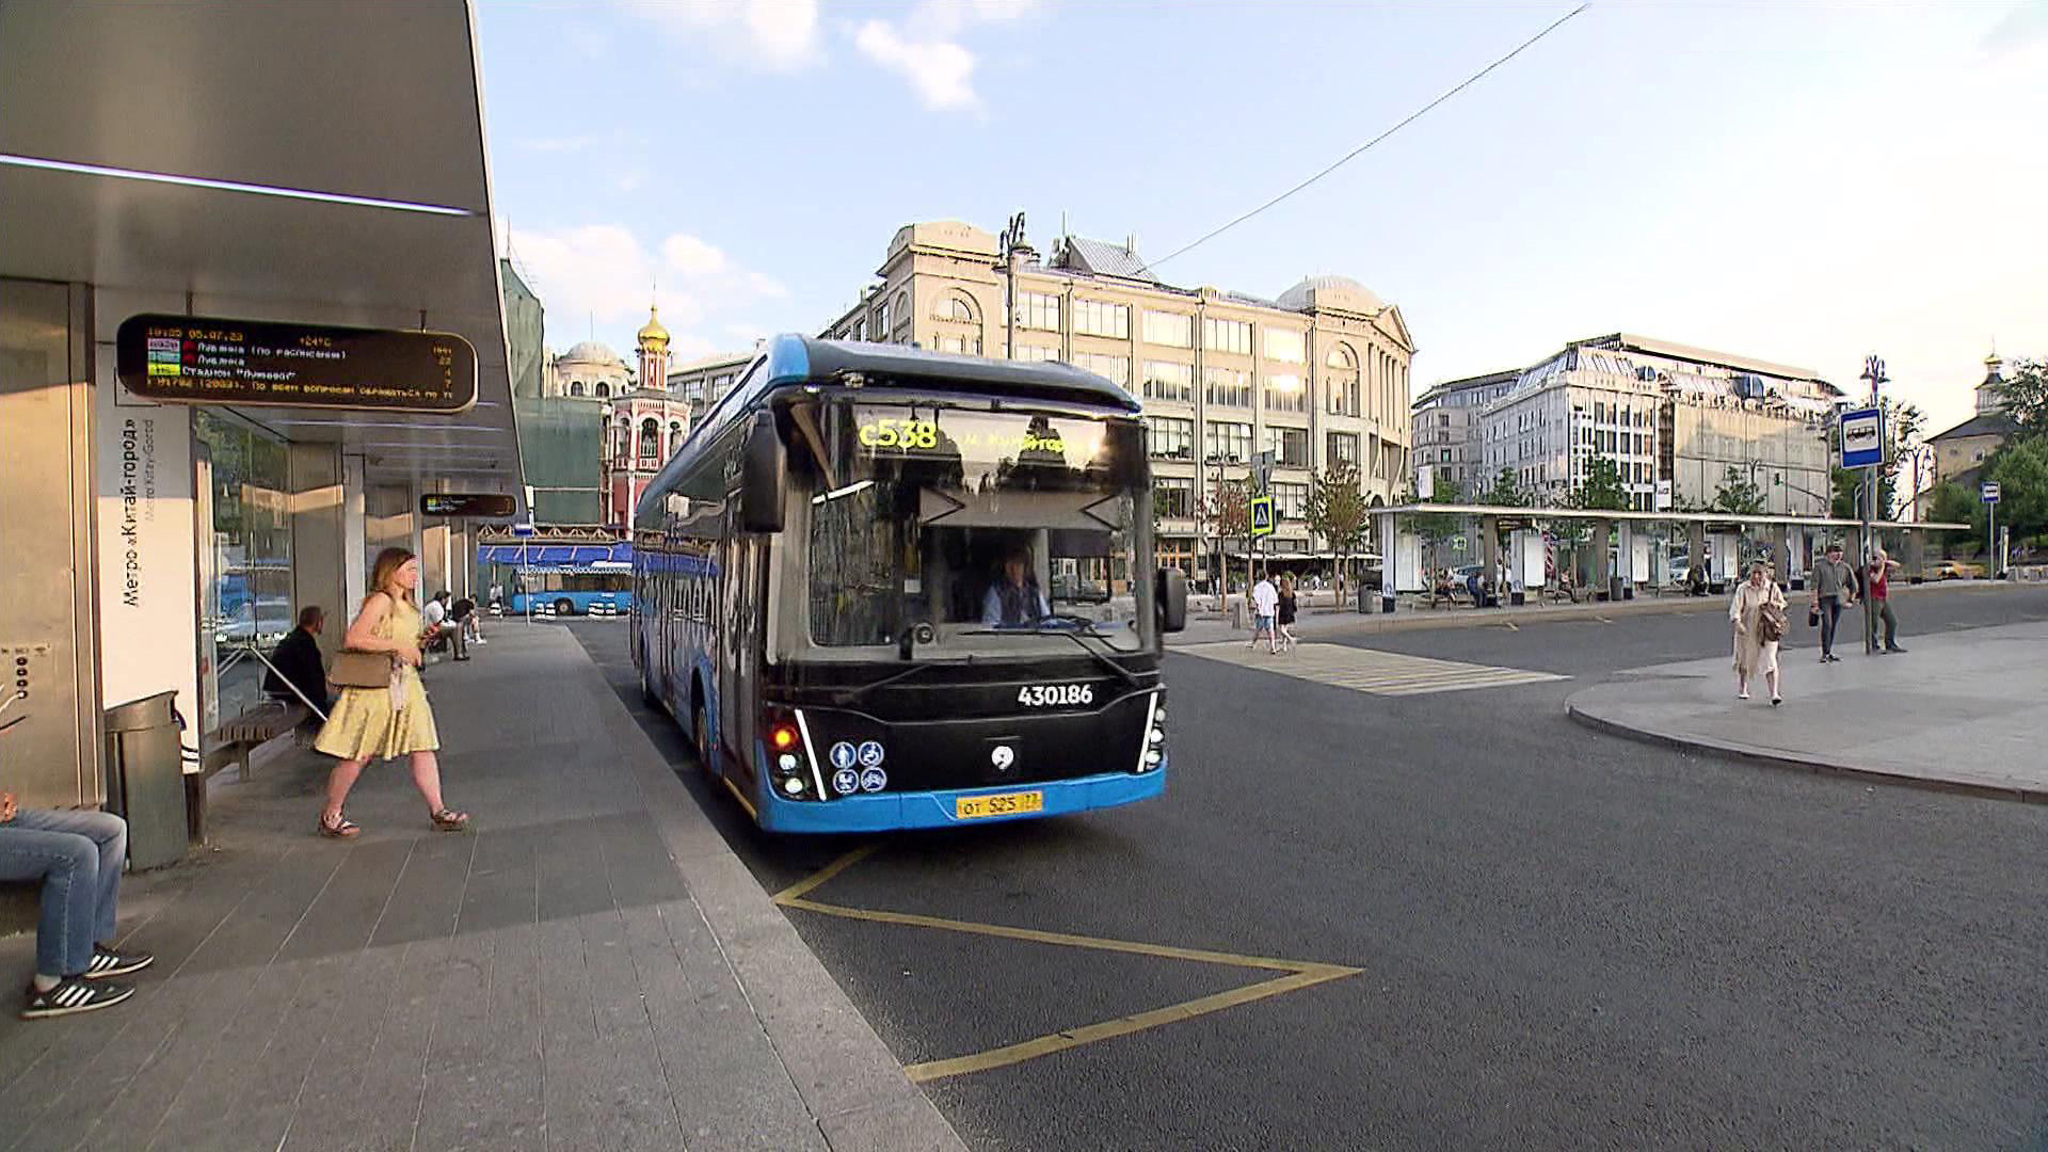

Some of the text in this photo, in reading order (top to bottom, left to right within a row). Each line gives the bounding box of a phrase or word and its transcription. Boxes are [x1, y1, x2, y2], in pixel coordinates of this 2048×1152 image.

[120, 419, 142, 607] Метро «Китай-город»
[1017, 684, 1093, 706] 430186
